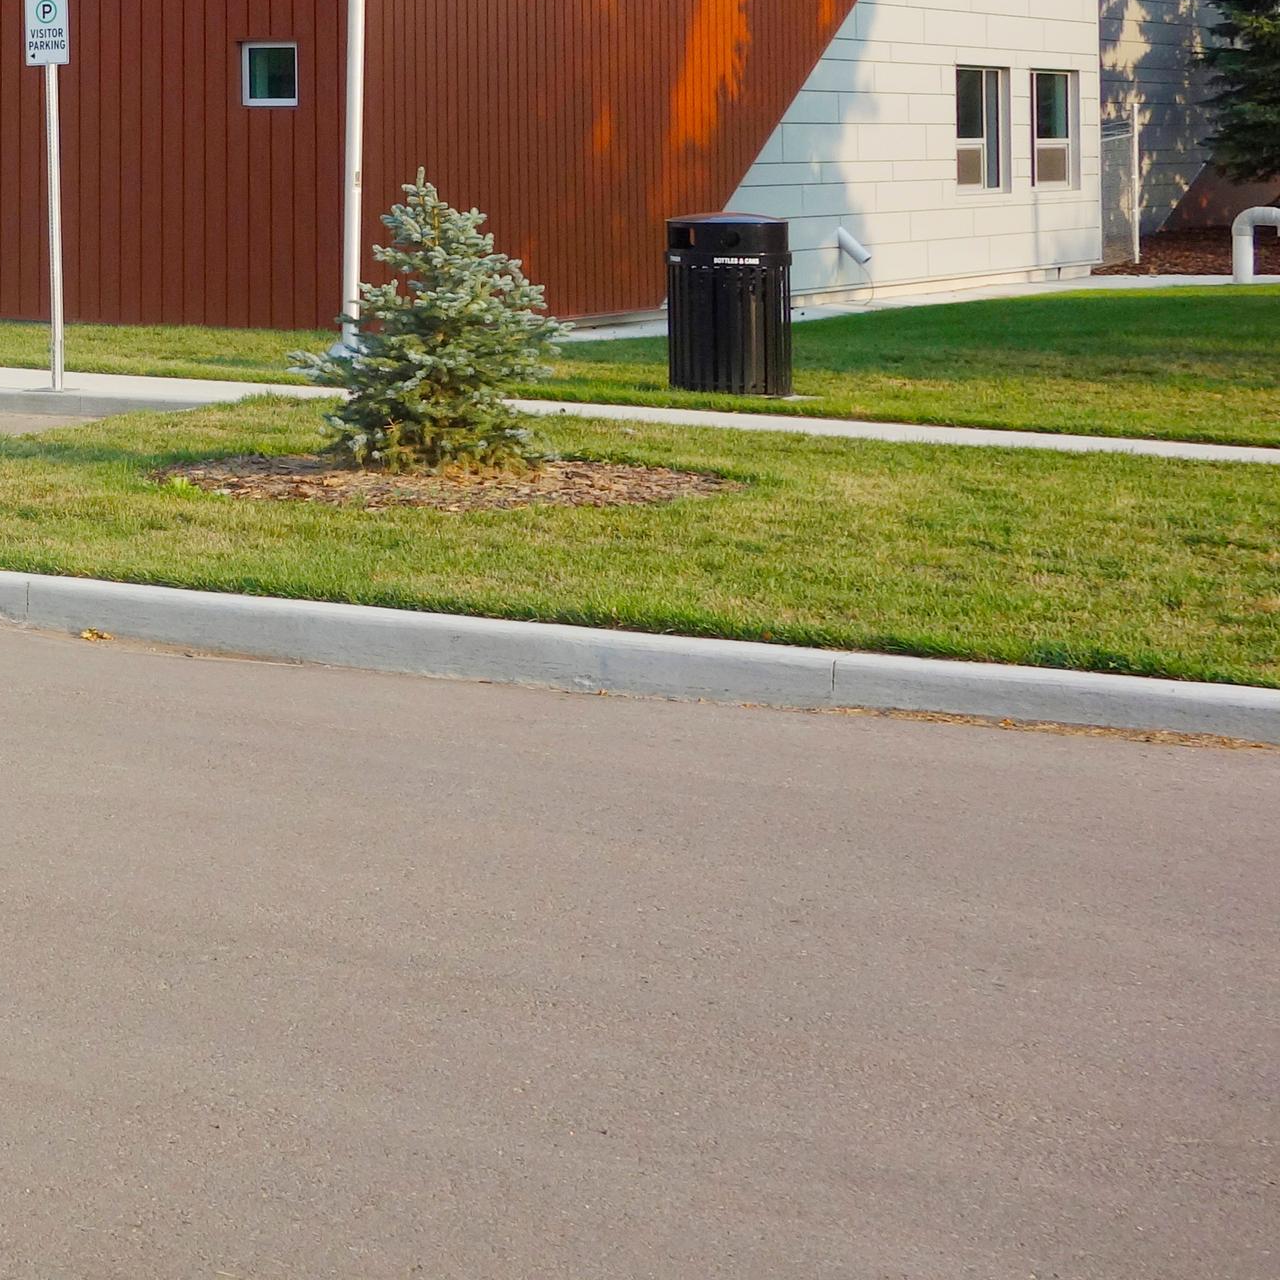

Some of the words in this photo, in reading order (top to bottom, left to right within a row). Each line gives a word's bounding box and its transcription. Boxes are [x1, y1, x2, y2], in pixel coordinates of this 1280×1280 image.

[42, 3, 52, 19] P
[30, 28, 63, 39] VISITOR
[29, 40, 65, 51] PARKING
